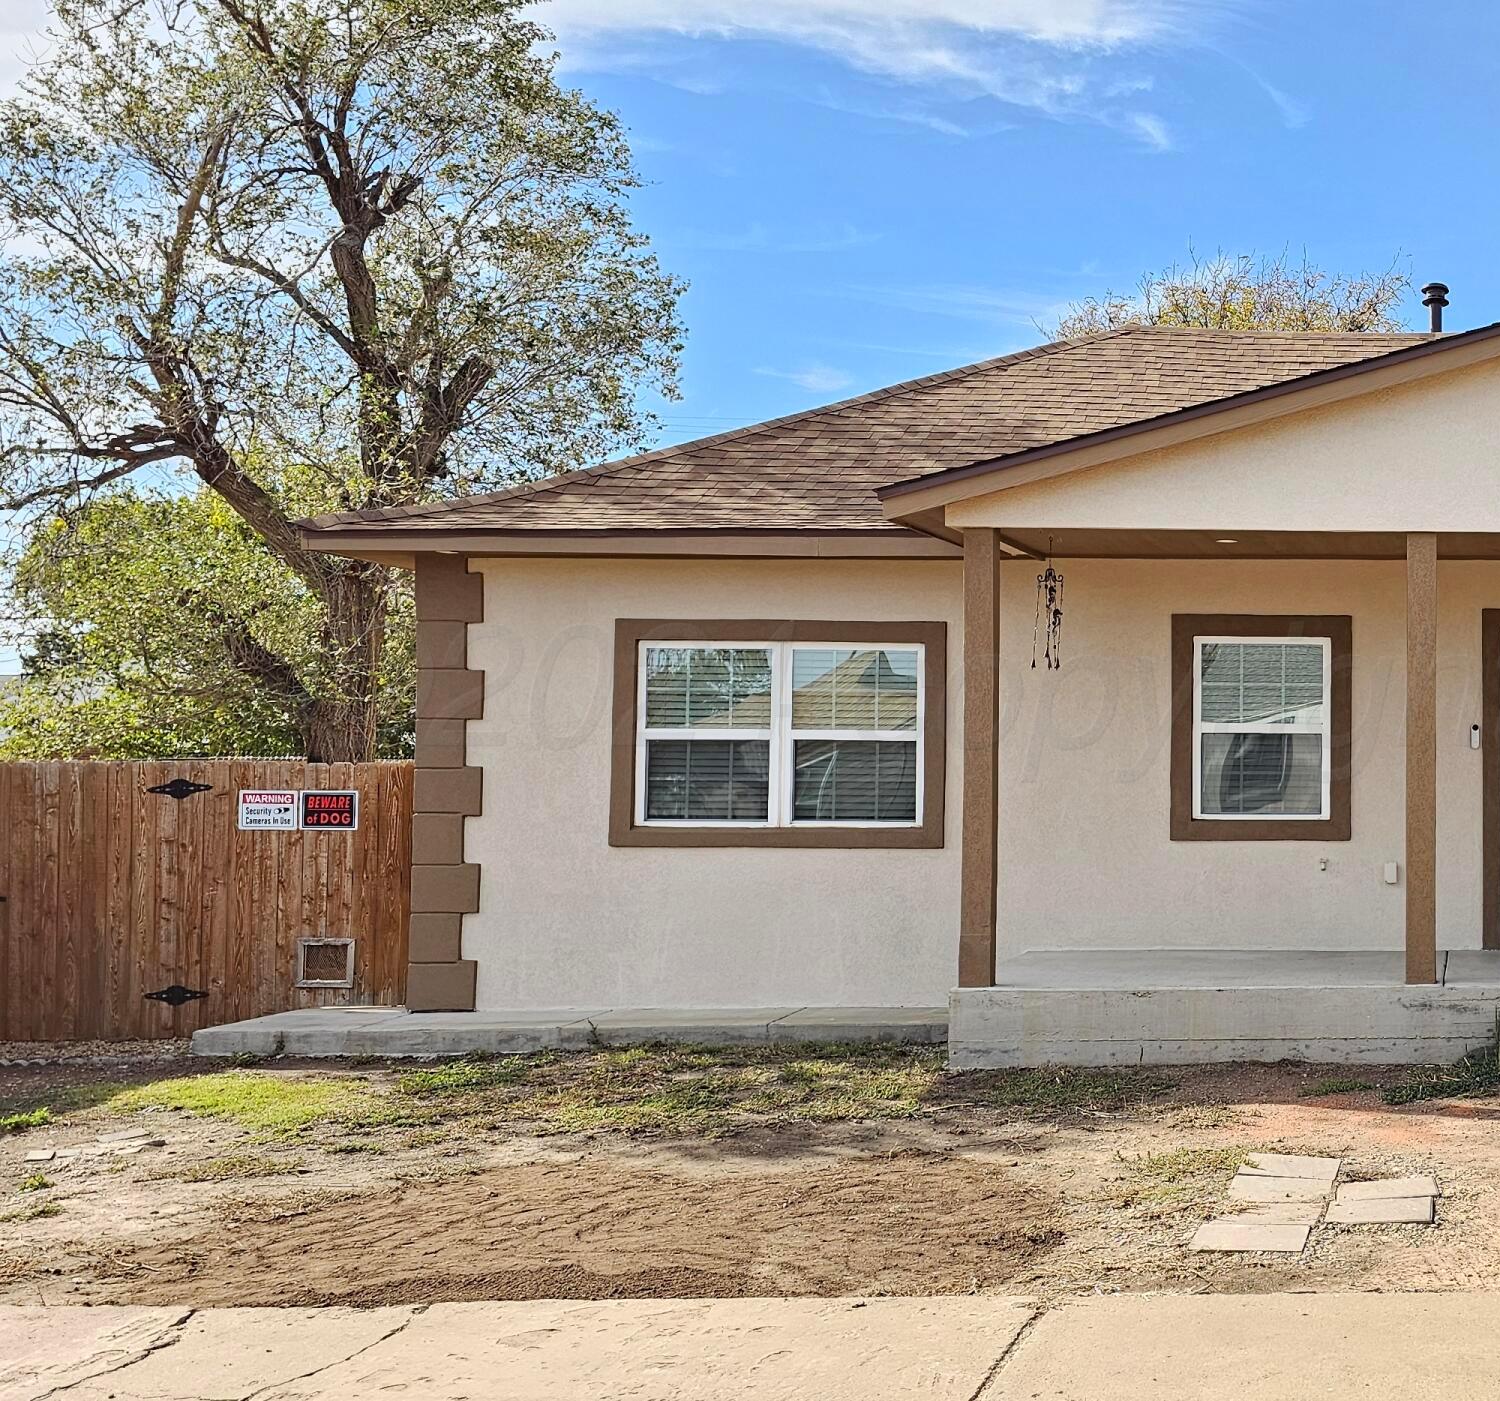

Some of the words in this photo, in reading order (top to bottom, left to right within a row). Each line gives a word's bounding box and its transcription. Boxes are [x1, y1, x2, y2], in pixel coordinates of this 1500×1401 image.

[245, 795, 292, 804] WARNING
[308, 796, 351, 809] BEWARE
[246, 807, 272, 816] Security
[246, 817, 271, 825] Cameras
[273, 817, 279, 825] In
[280, 817, 290, 825] Use
[307, 813, 318, 824] of
[320, 813, 351, 824] DOG
